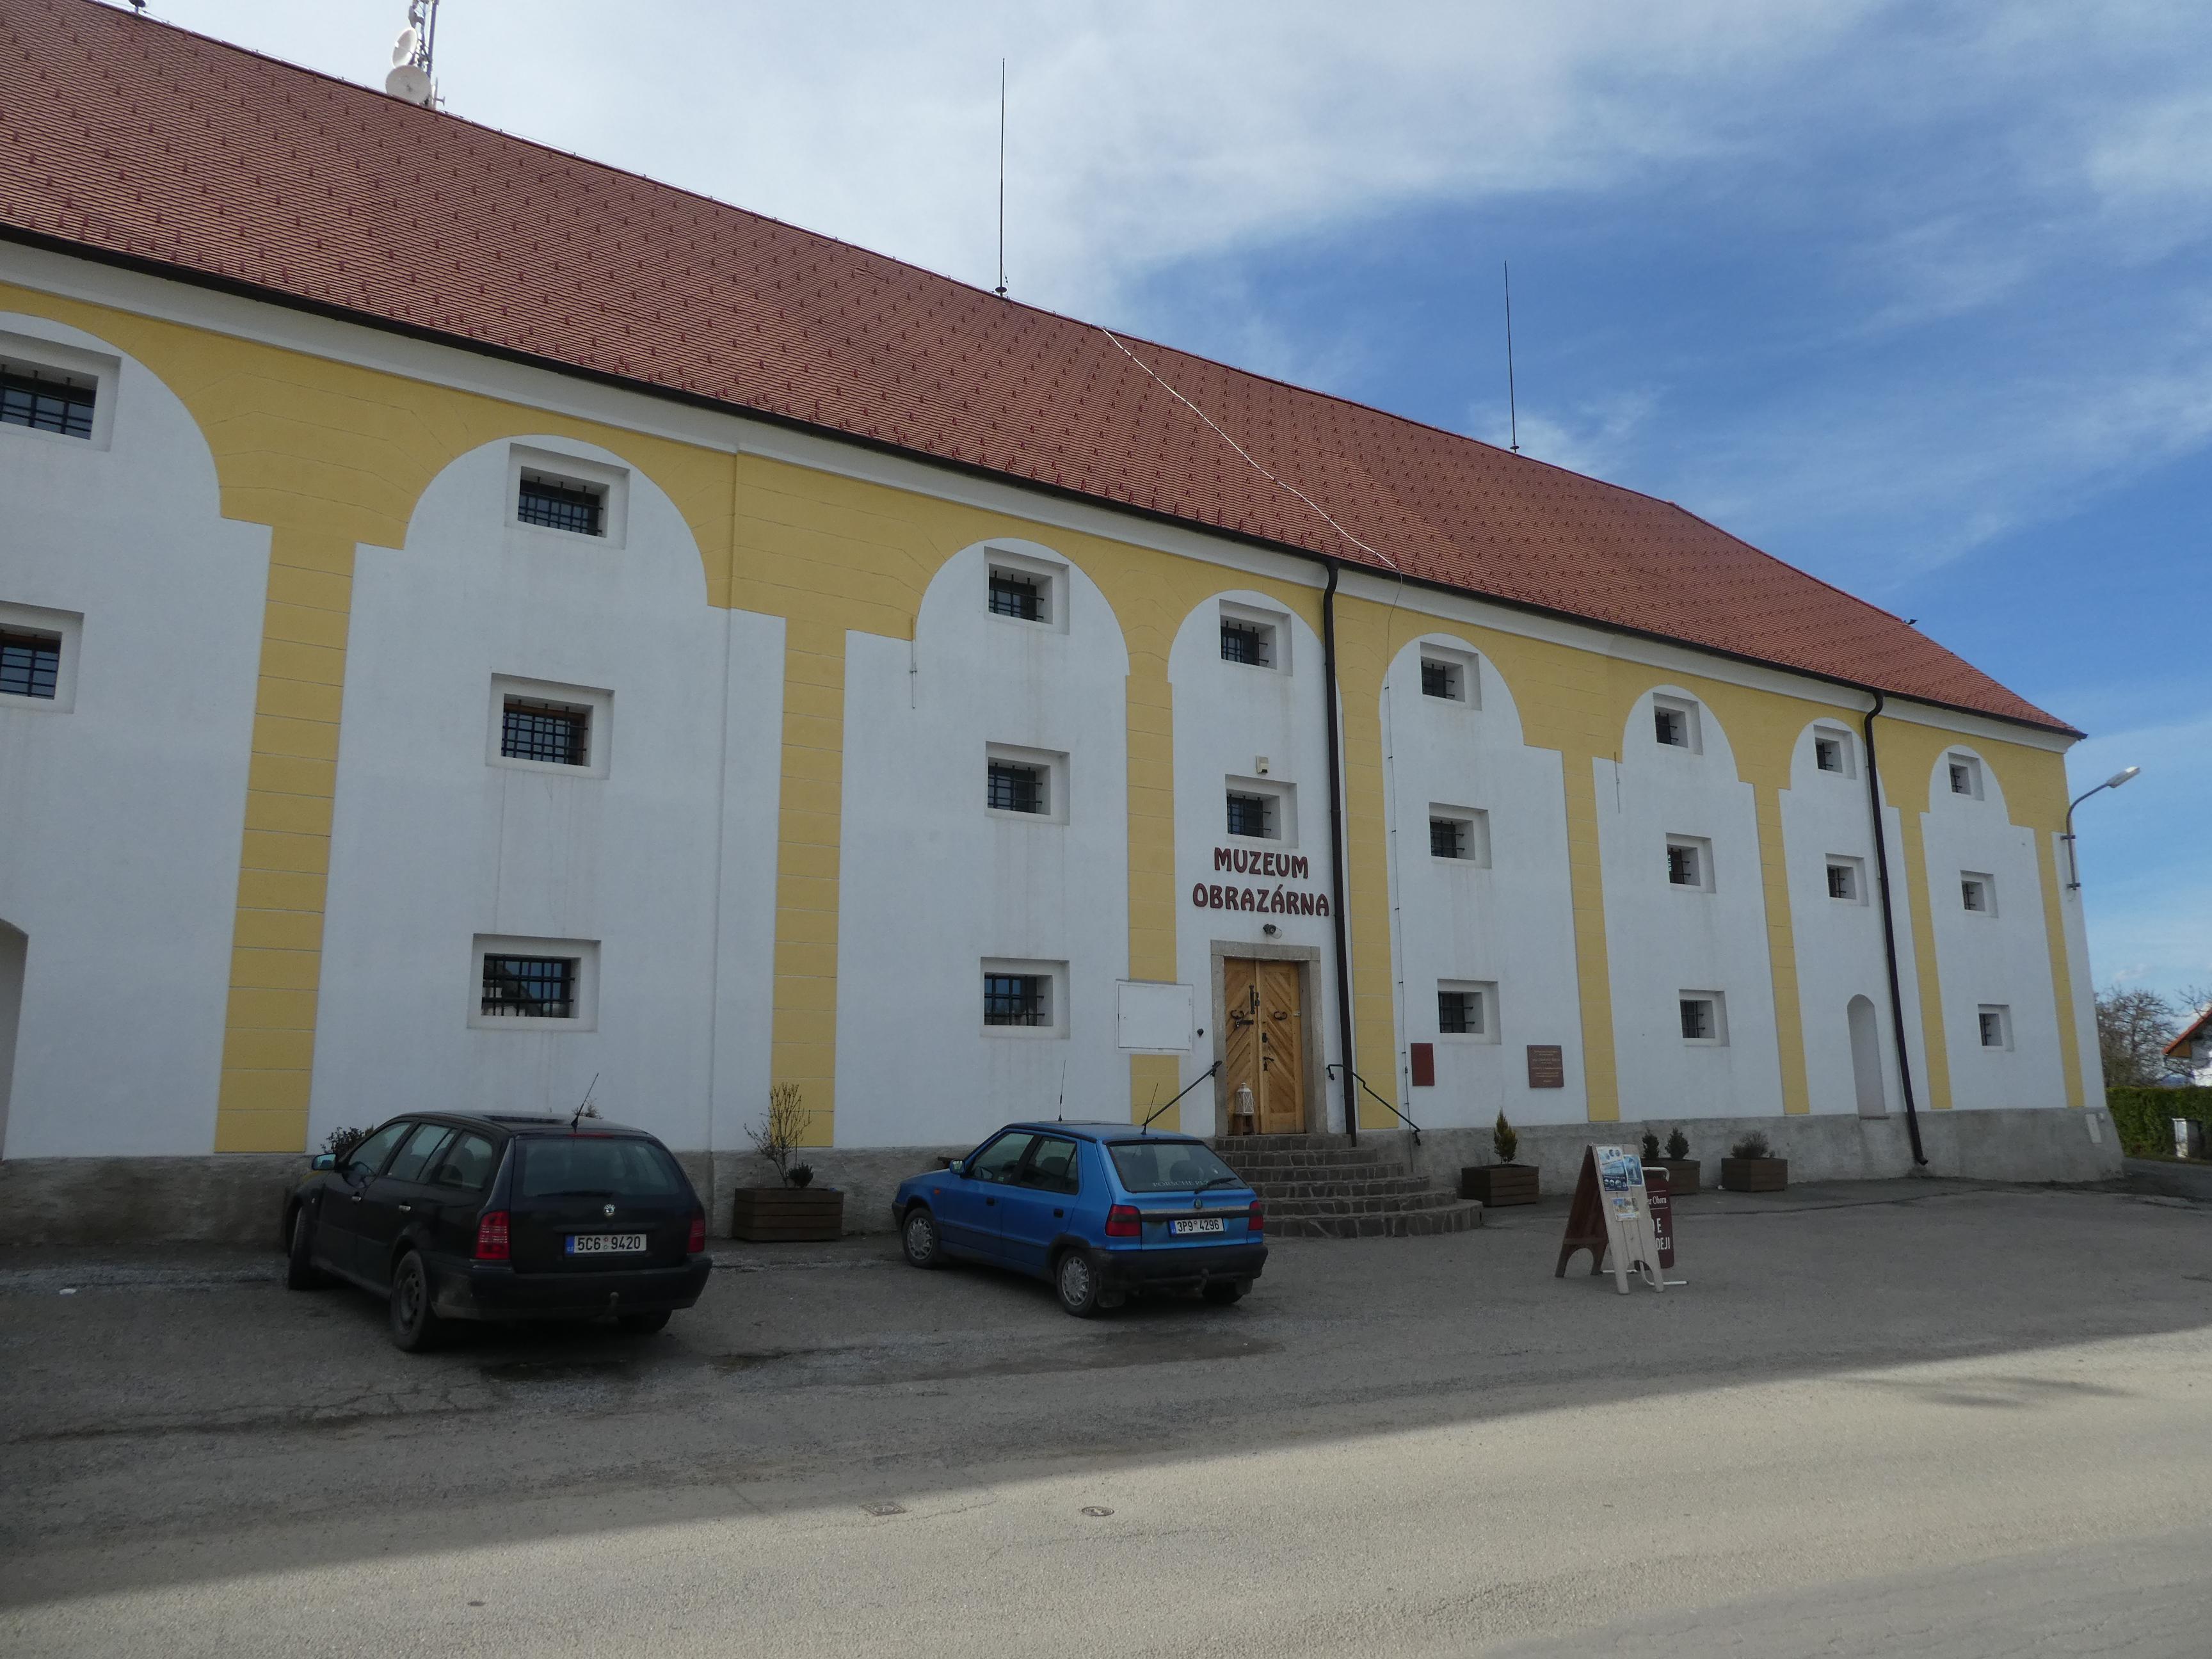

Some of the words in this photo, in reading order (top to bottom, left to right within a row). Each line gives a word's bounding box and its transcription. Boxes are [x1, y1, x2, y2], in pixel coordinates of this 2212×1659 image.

[1214, 847, 1308, 879] MUZEUM
[1192, 883, 1329, 917] OBRAZÁRNA
[1177, 1221, 1194, 1232] 3P9
[1199, 1219, 1220, 1231] 4296
[577, 1237, 601, 1251] 5C6
[611, 1235, 641, 1250] 9420
[1656, 1237, 1671, 1250] DEJI
